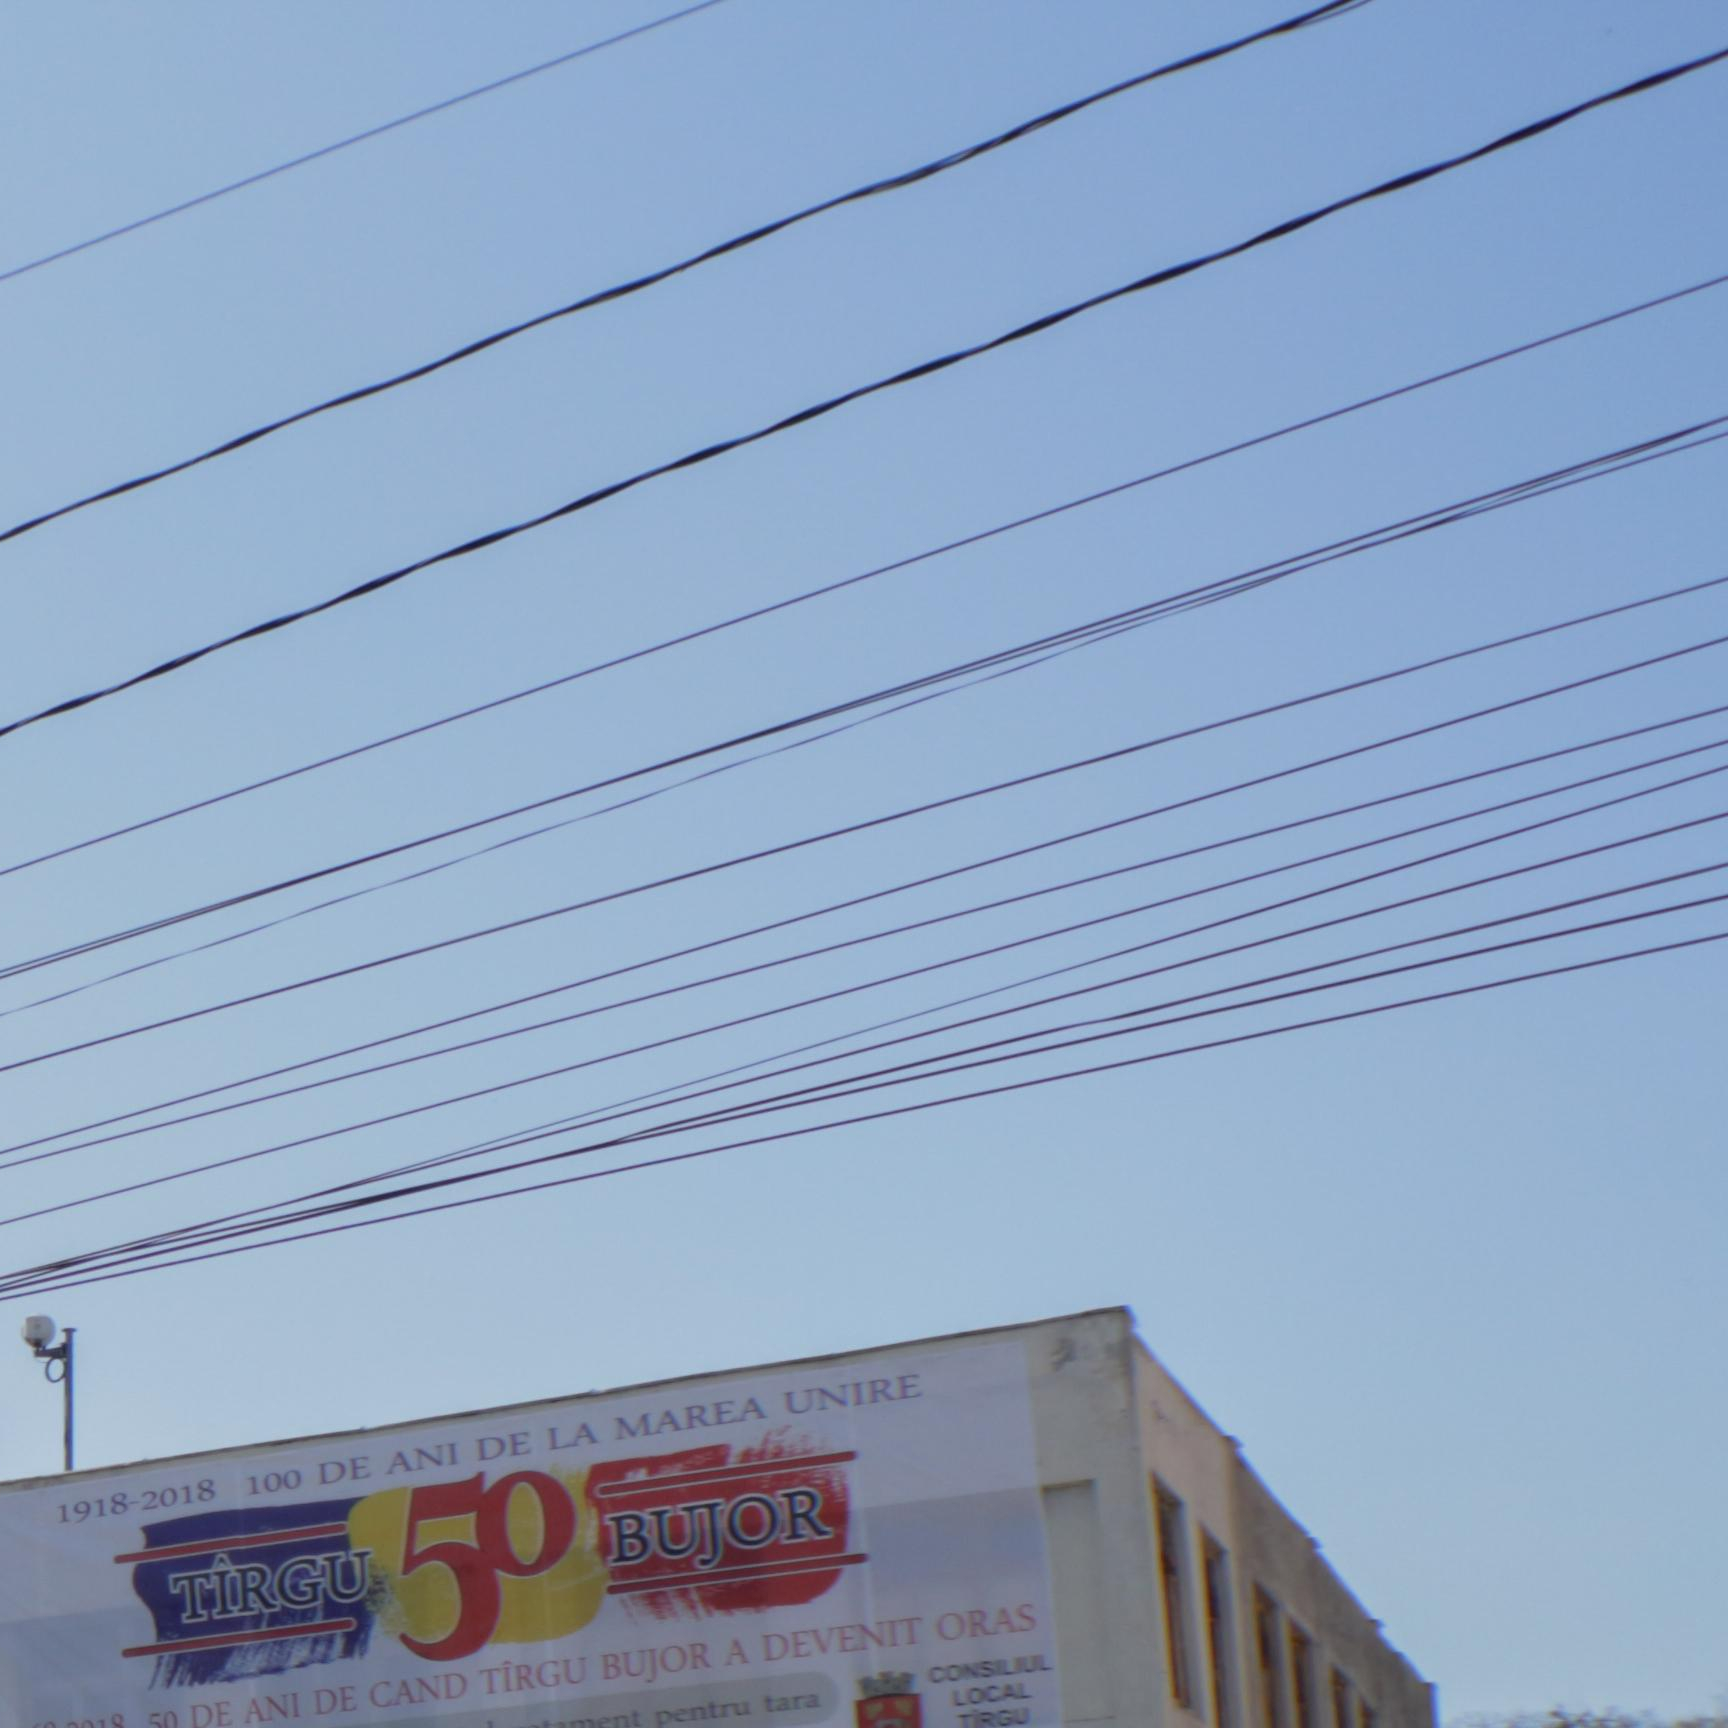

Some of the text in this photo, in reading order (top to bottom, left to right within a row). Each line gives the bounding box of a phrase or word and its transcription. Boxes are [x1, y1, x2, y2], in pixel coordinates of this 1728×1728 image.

[57, 1373, 923, 1524] 1918-2018 100 DE ANI DE LA MAREA UNIRE
[167, 1470, 833, 1662] TÎRGU 50 BUJOR
[244, 1693, 301, 1725] ANI
[313, 1685, 357, 1716] DE
[369, 1672, 468, 1709] CAND
[479, 1656, 587, 1695] TÎRGU
[602, 1642, 711, 1683] BUJOR
[723, 1638, 750, 1667] A
[762, 1616, 923, 1661] DEVENIT
[936, 1603, 1039, 1642] ORAS
[764, 1690, 823, 1714] tara
[928, 1654, 1054, 1684] CONSILIUL
[951, 1682, 1033, 1706] LOCAL
